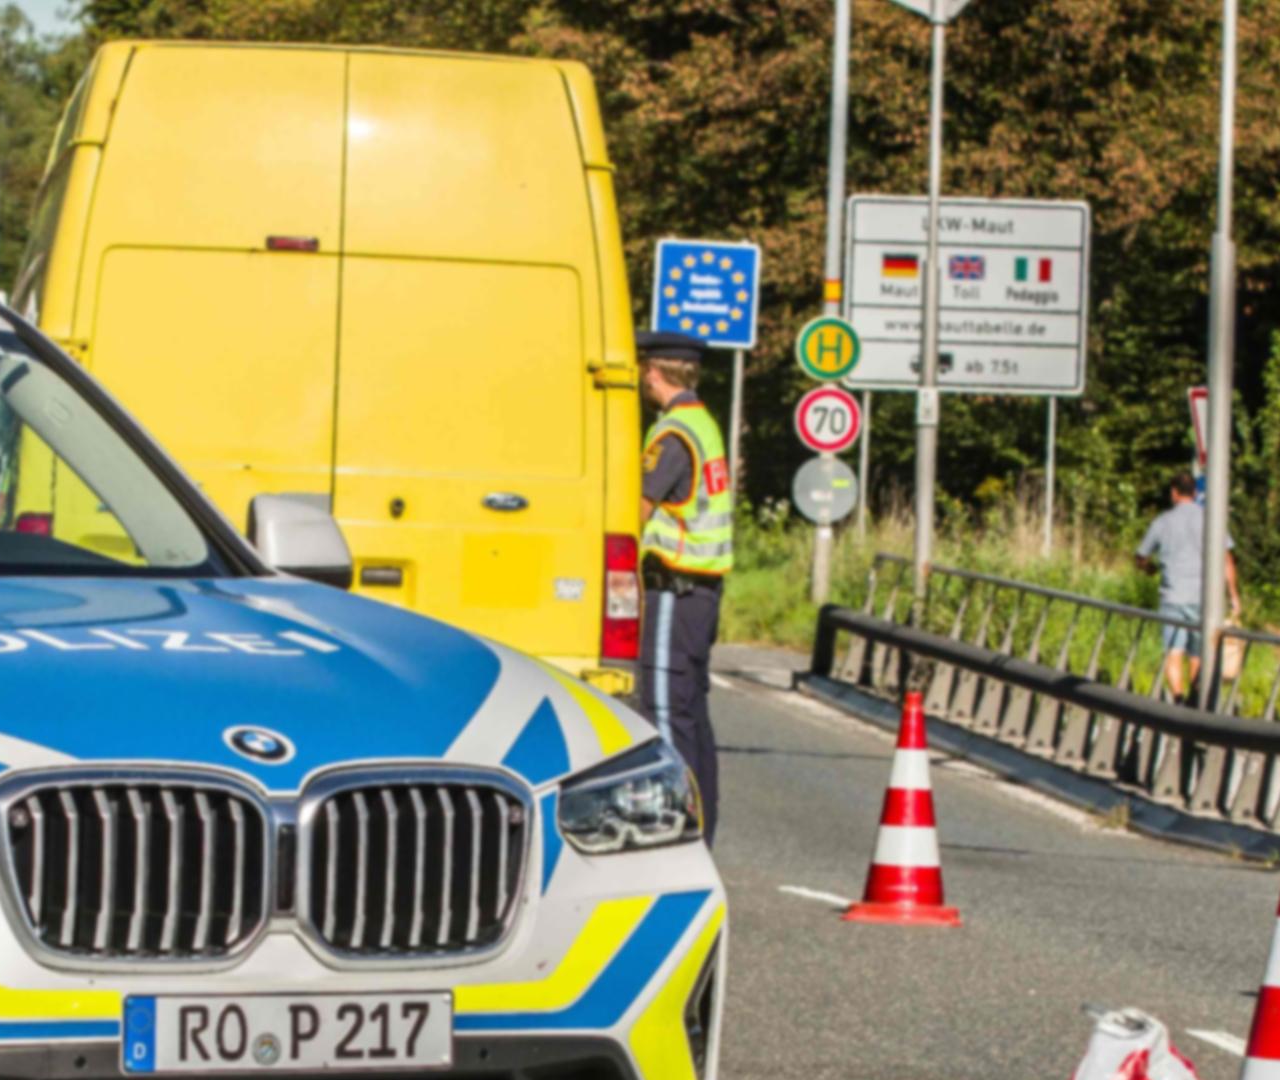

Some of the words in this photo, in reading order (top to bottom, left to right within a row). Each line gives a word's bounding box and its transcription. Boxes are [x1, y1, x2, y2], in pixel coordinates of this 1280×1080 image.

[953, 286, 980, 300] Toll
[1006, 287, 1059, 306] Pedaggio
[817, 333, 842, 366] H
[965, 360, 984, 375] ab
[813, 406, 847, 435] 70
[179, 1003, 248, 1062] RO
[289, 1004, 321, 1060] P
[335, 1001, 430, 1060] 217
[133, 1042, 147, 1060] D
